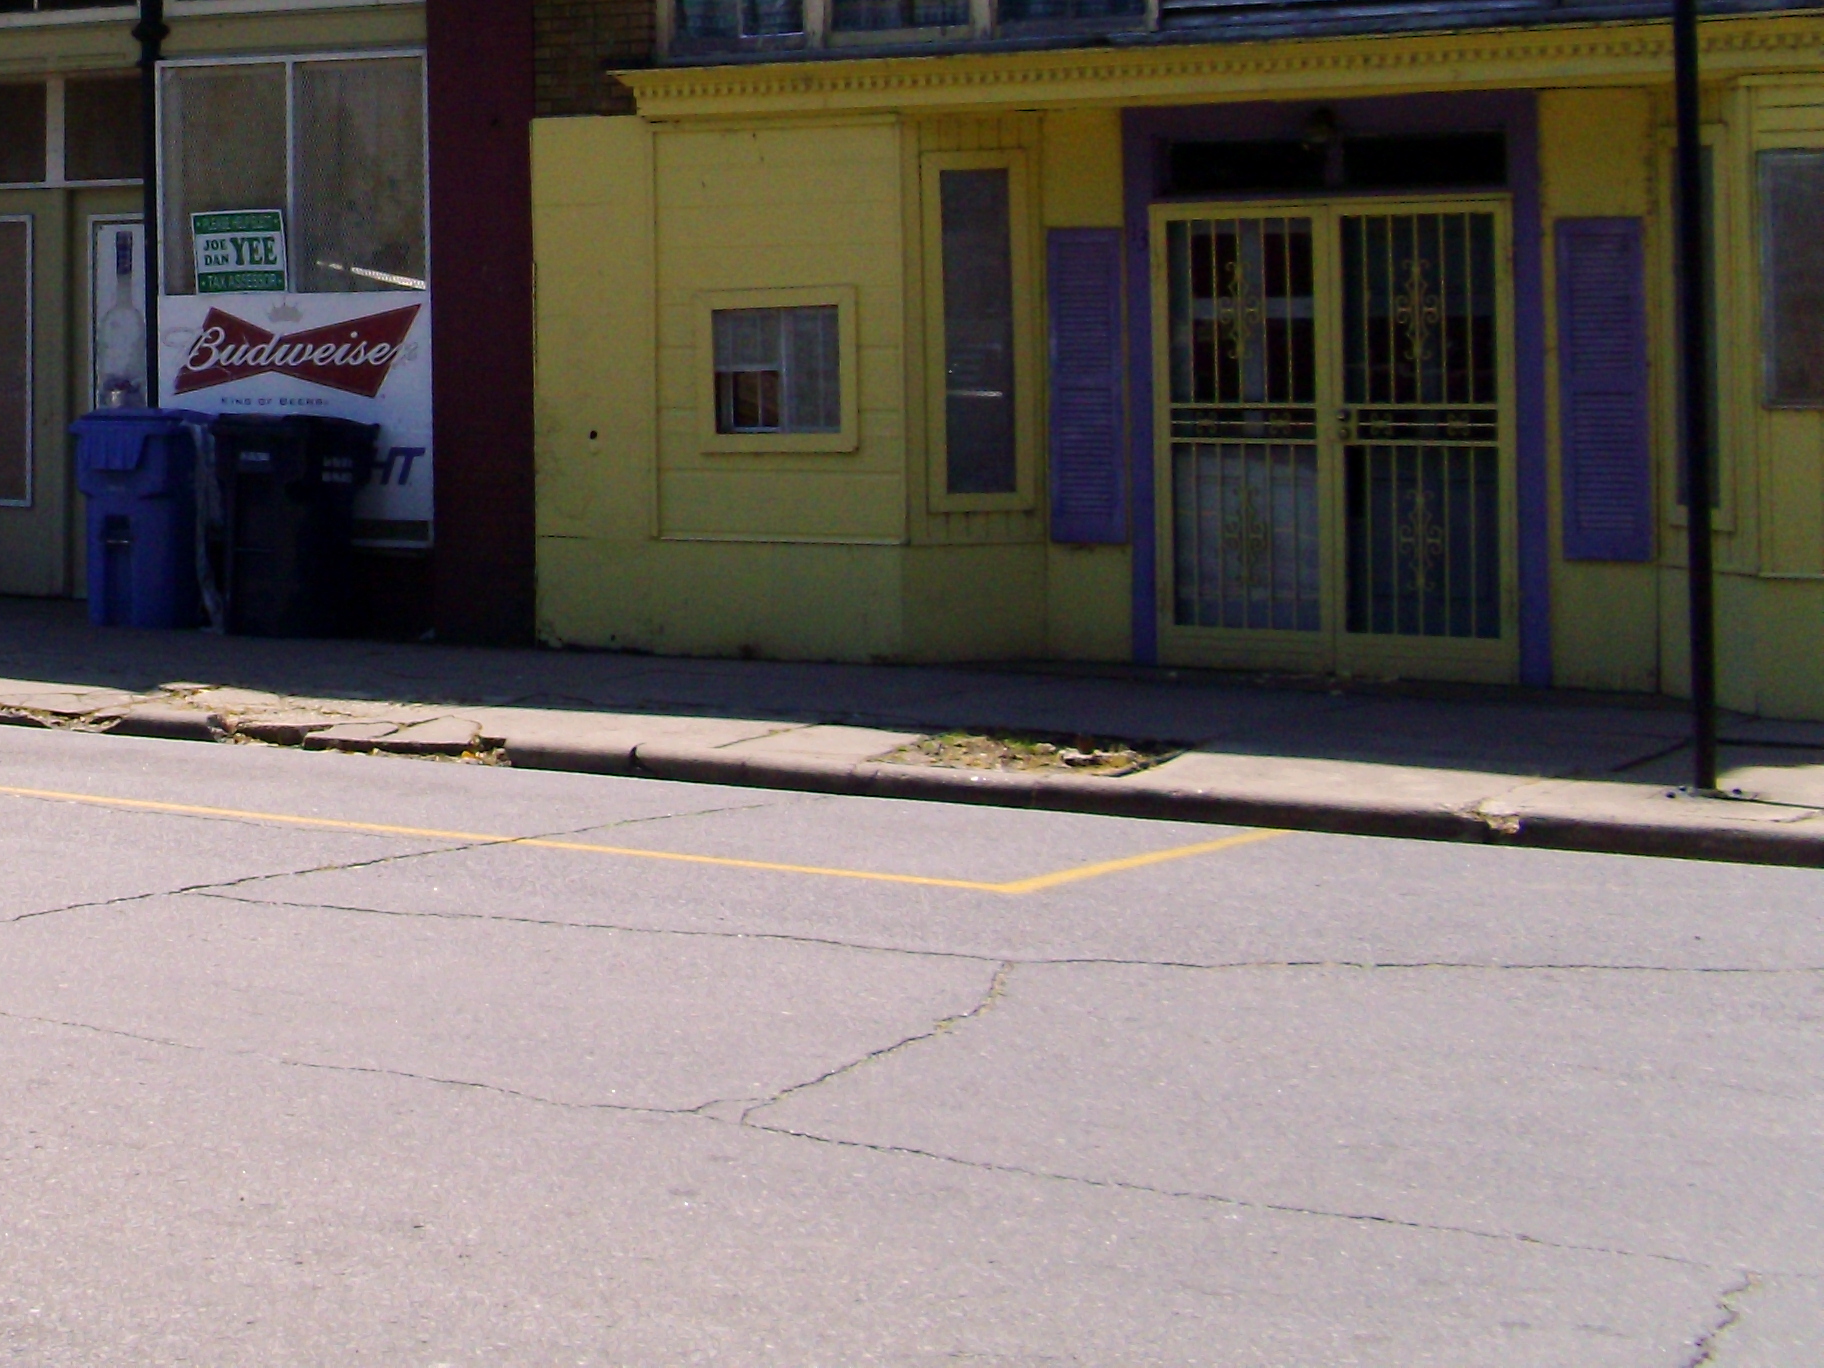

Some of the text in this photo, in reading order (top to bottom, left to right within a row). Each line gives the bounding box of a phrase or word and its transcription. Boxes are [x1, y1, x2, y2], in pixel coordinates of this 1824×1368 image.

[203, 238, 227, 251] JOE
[229, 236, 278, 266] YEE
[204, 254, 229, 266] DAN
[207, 275, 228, 289] TAX
